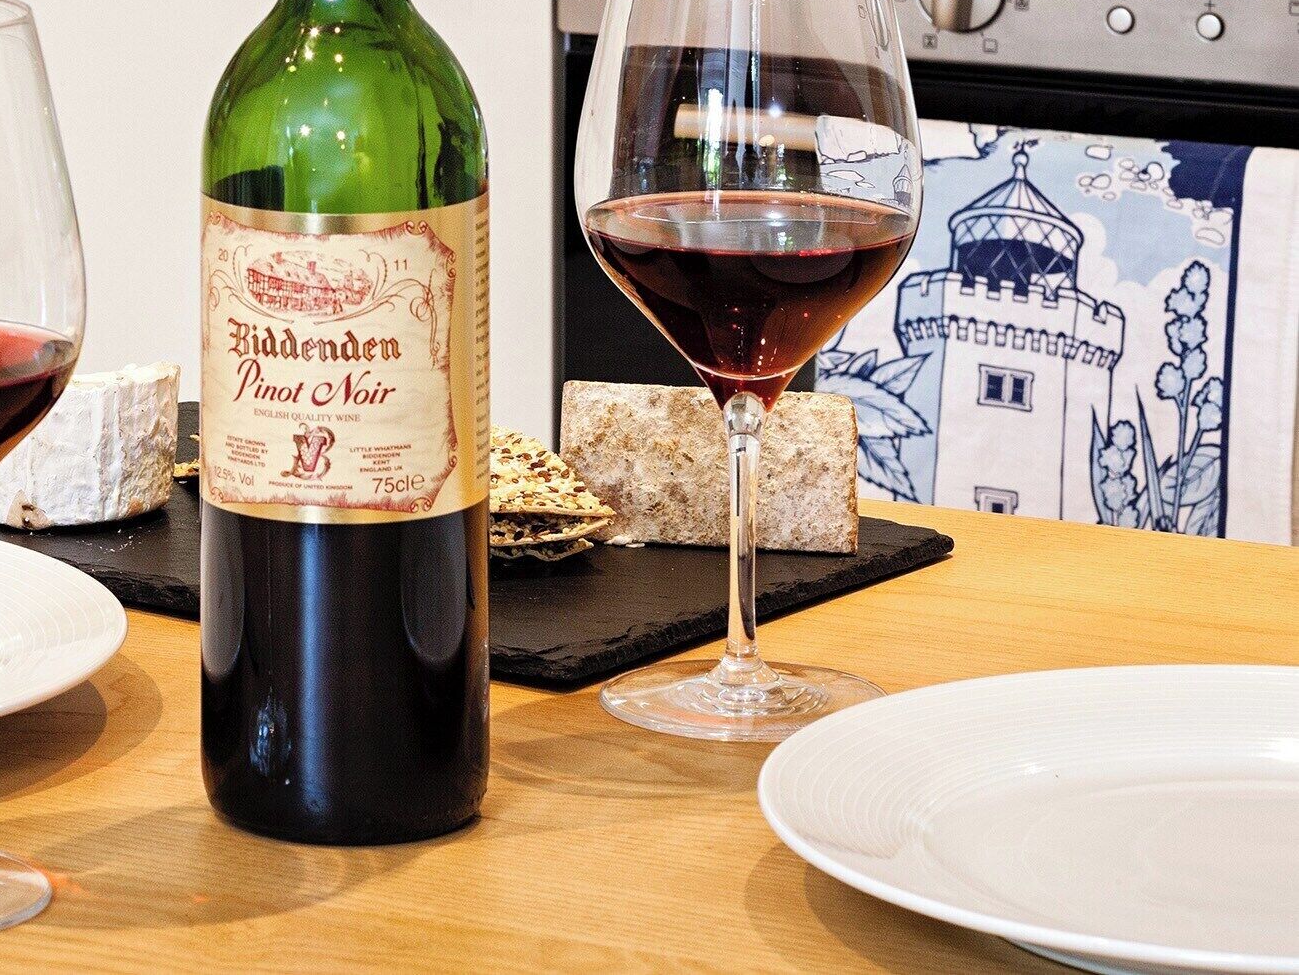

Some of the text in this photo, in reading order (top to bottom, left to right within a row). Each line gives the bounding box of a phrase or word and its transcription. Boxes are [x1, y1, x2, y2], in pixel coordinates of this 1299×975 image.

[228, 317, 402, 362] Biddenden
[233, 358, 397, 406] Pinot Noir
[254, 408, 361, 422] ENGLISH QUALITY WINE
[362, 451, 401, 459] BIDDENDEN
[238, 472, 255, 486] Vol
